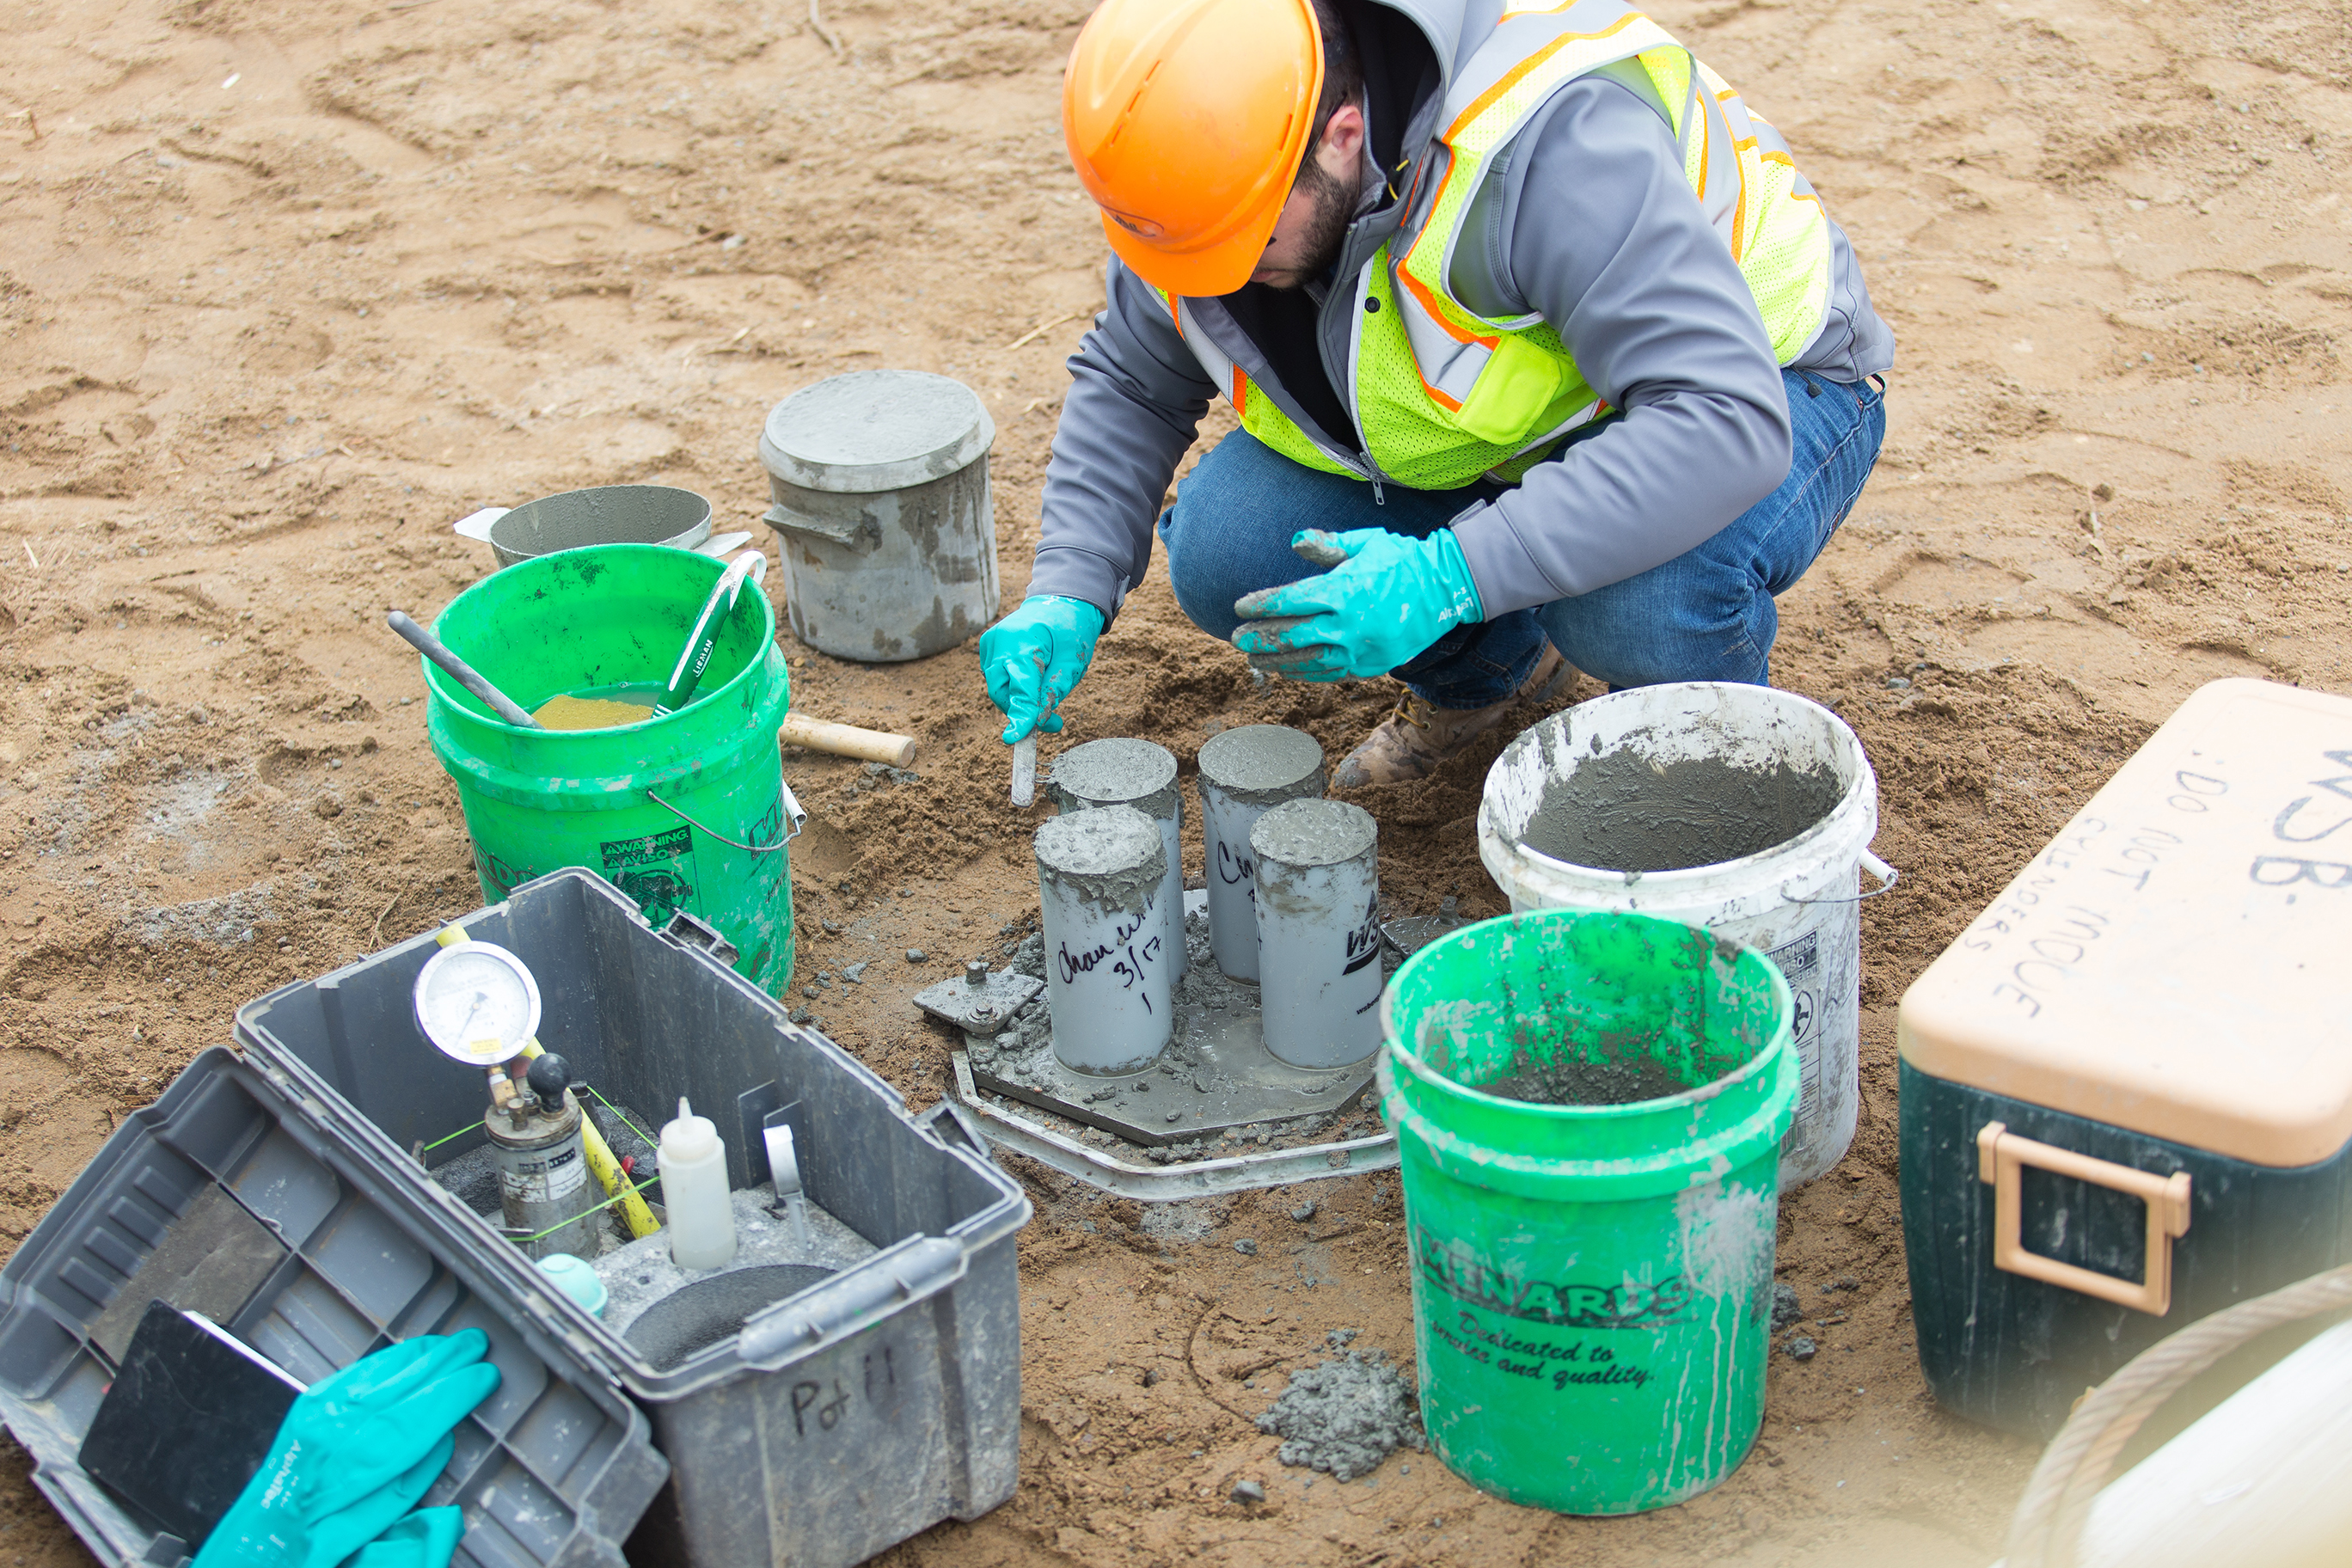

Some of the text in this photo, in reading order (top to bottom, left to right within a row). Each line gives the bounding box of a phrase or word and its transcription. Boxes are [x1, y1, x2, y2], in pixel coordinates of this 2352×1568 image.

[2102, 827, 2184, 891] NOT
[1416, 1223, 1696, 1326] MENARDS
[1458, 1309, 1615, 1363] Dedicated to
[1497, 1357, 1547, 1381] and
